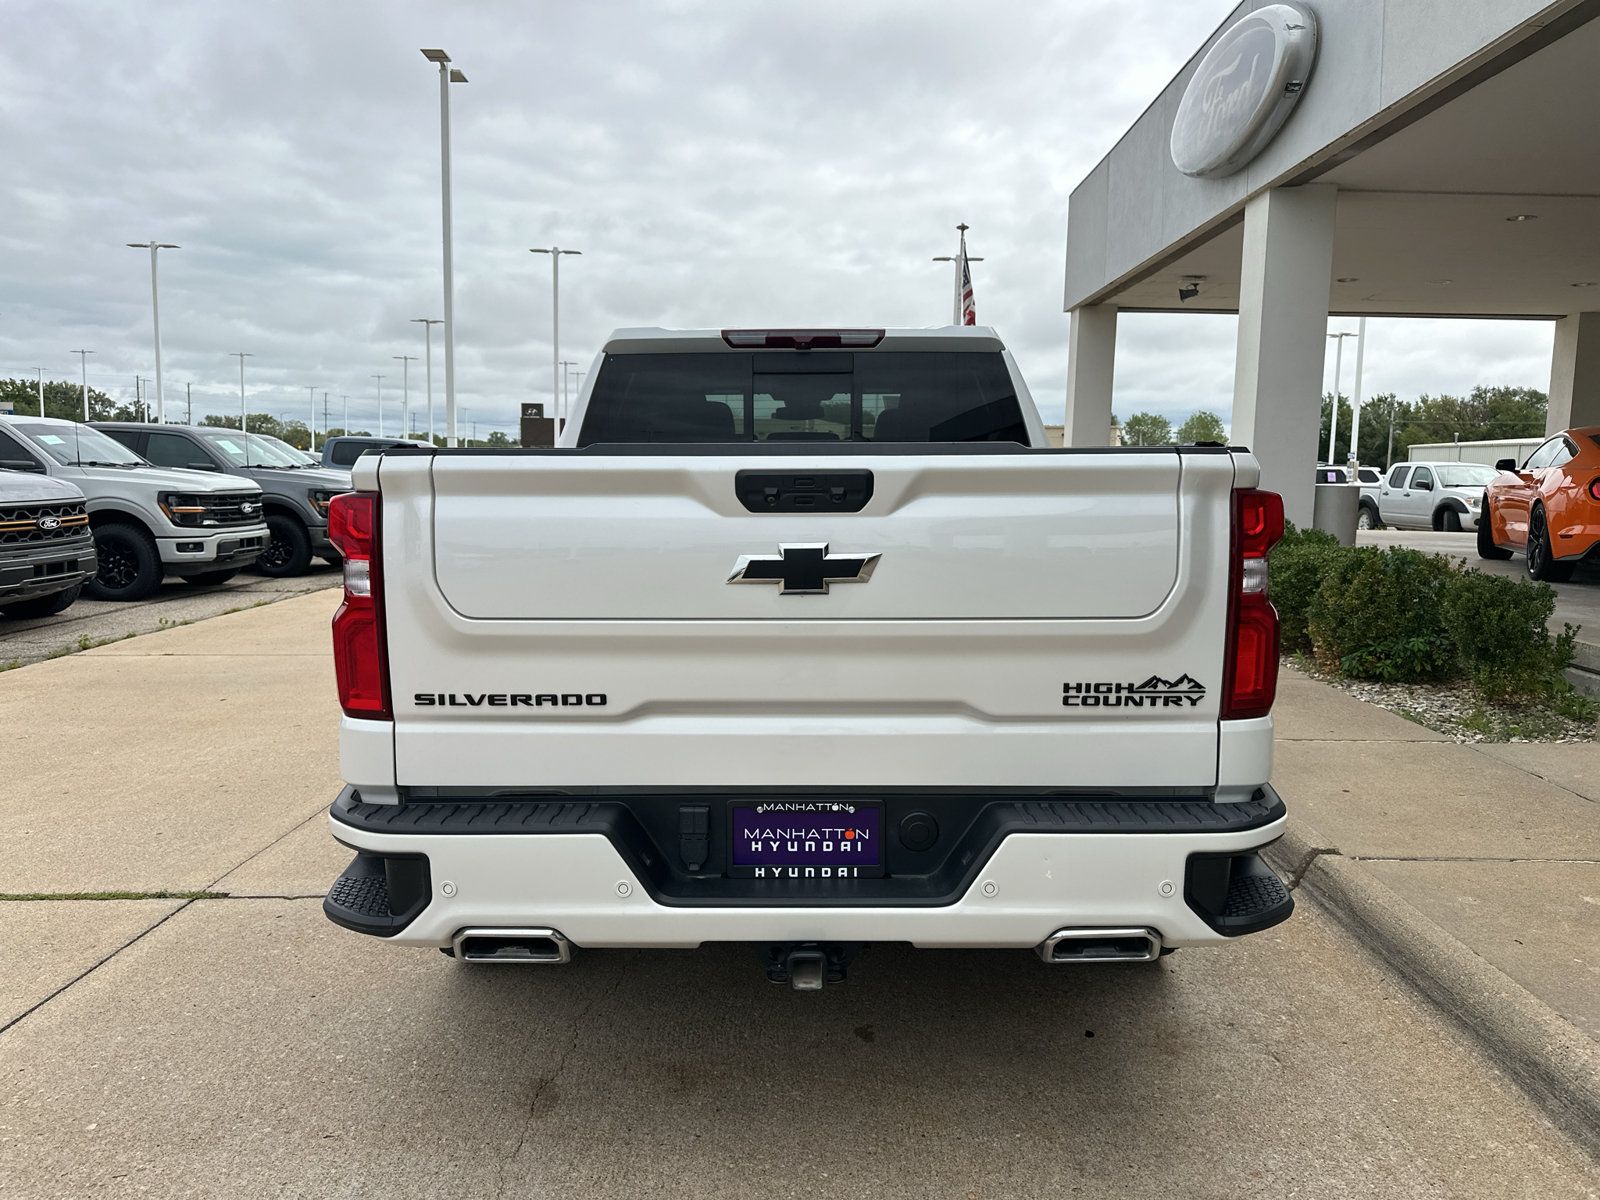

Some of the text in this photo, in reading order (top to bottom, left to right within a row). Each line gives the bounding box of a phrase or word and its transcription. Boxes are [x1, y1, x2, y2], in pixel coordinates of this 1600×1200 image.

[1063, 683, 1135, 694] HIGH
[414, 693, 608, 707] SILVERADO
[1062, 695, 1205, 707] COUNTRY
[763, 802, 849, 812] MANHATTN
[744, 828, 869, 840] MANHATTN
[751, 841, 862, 852] HYUNDAI
[755, 867, 858, 878] HYUNDAI
